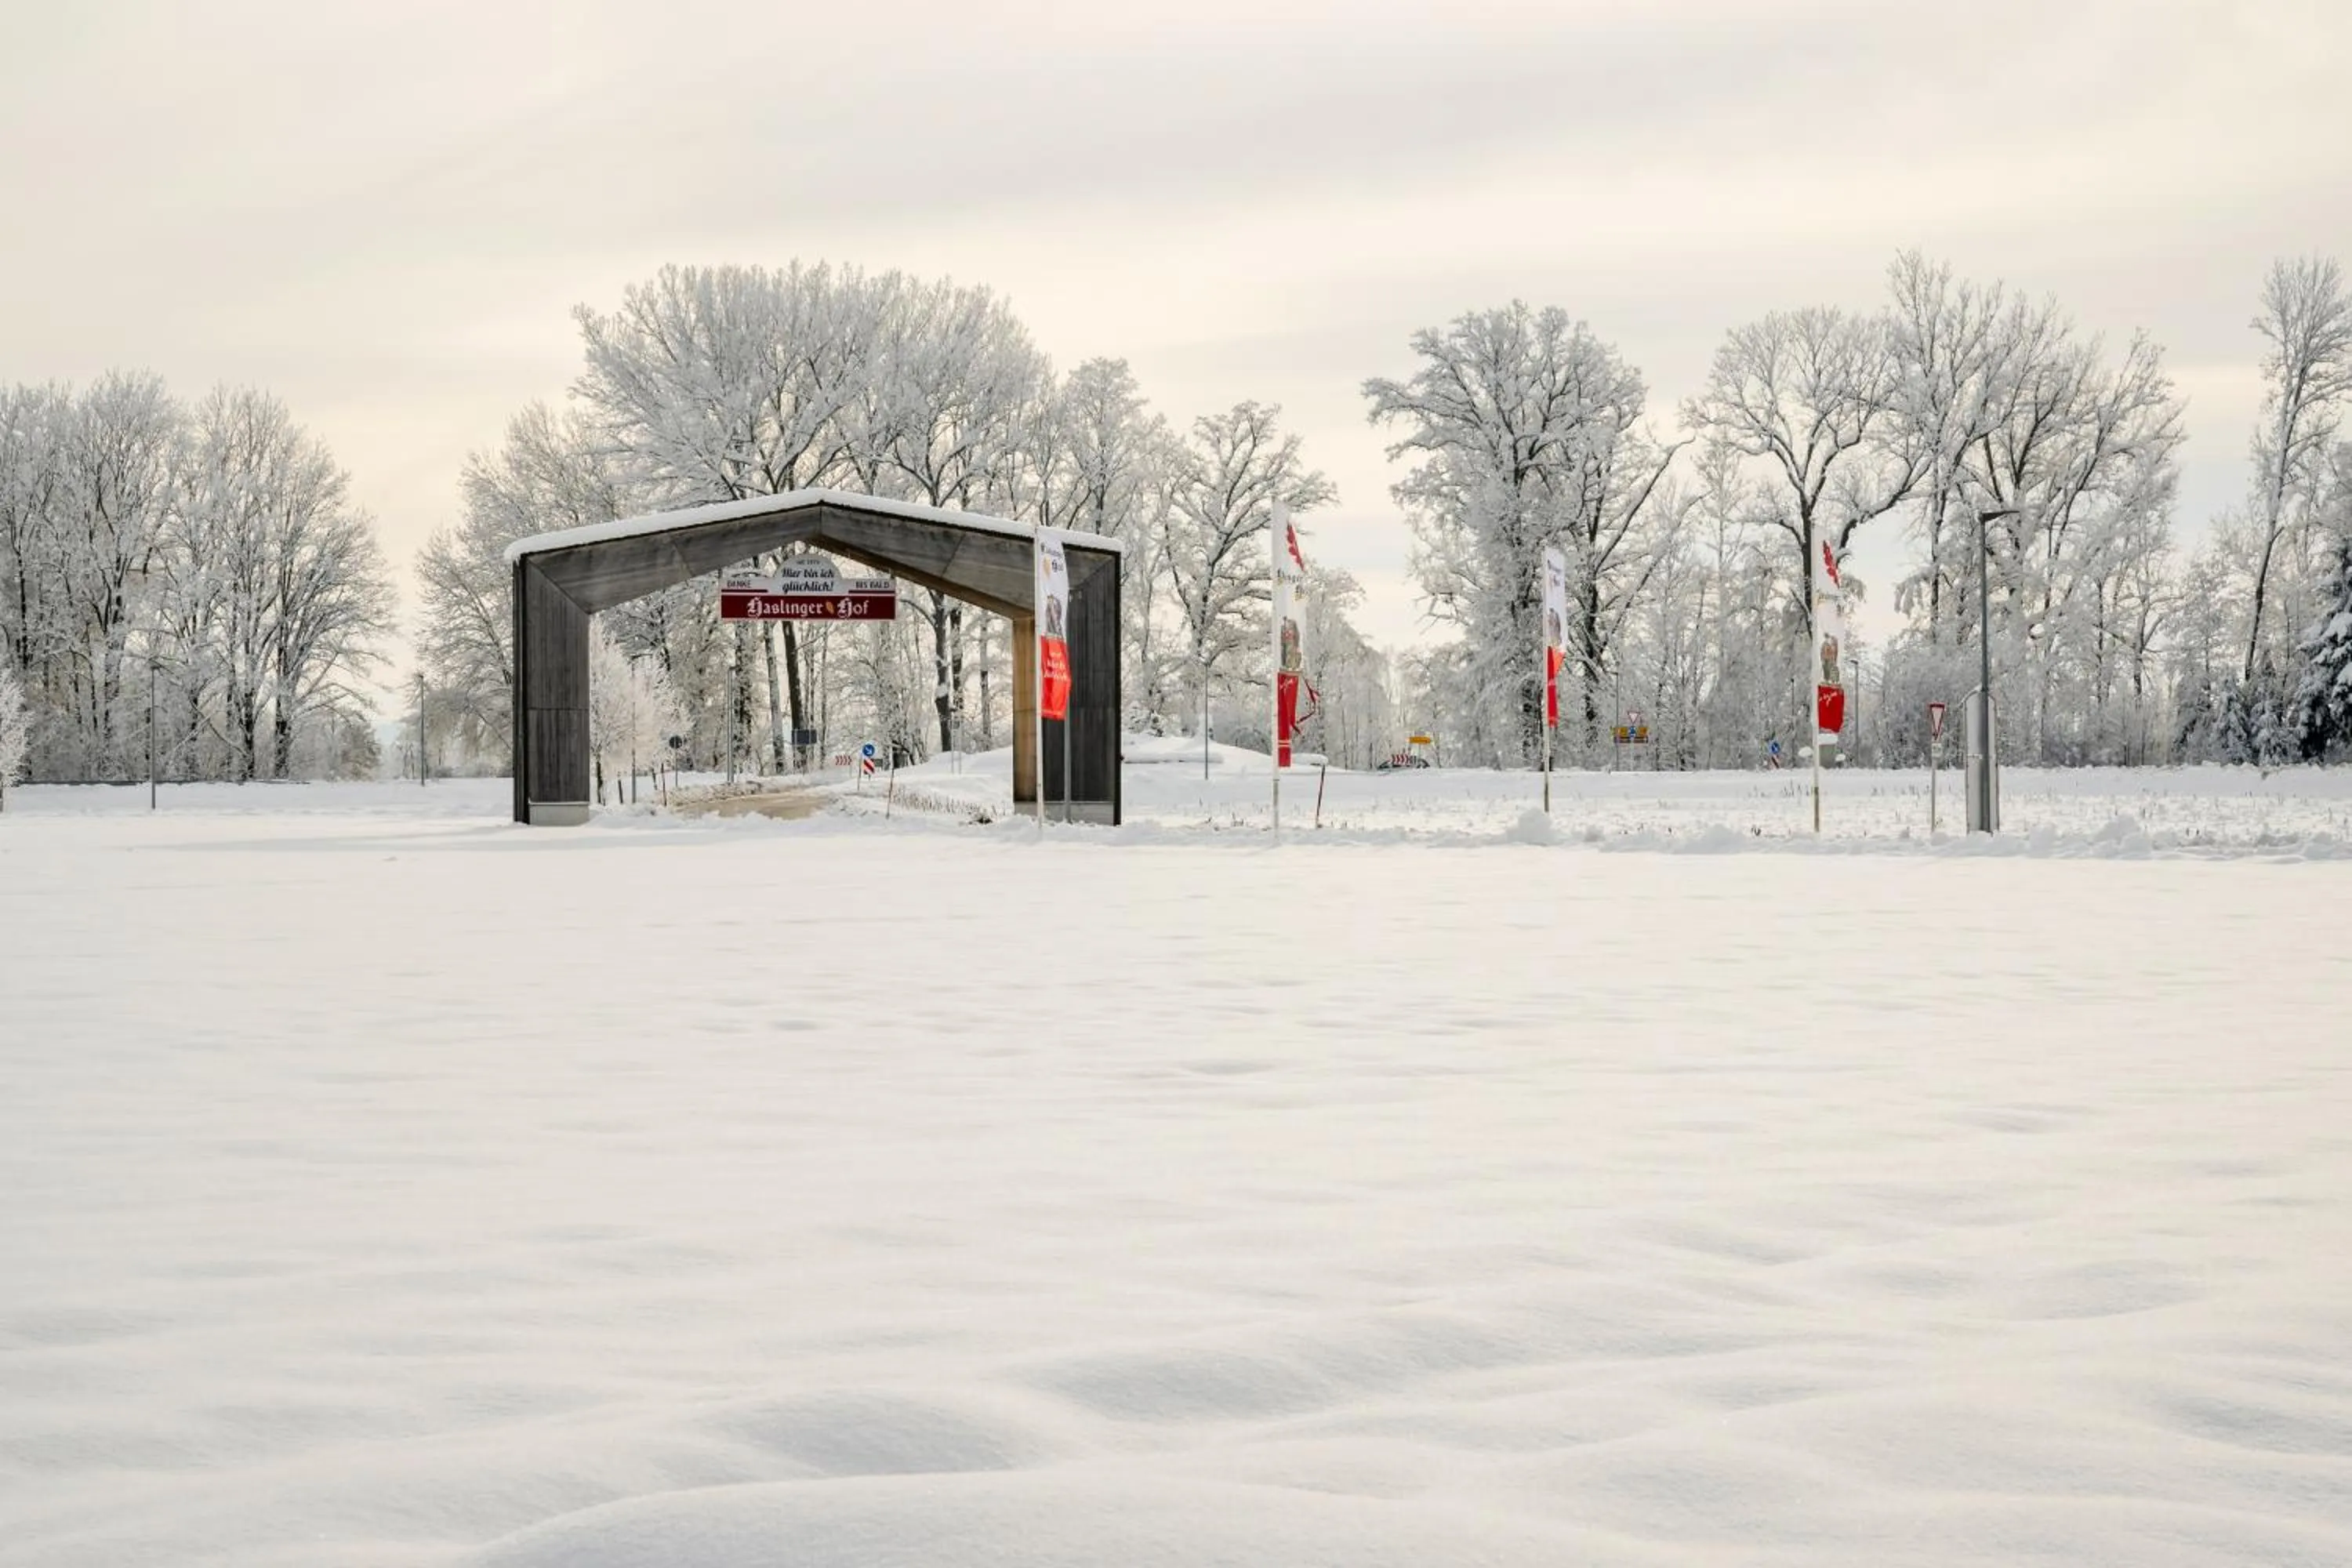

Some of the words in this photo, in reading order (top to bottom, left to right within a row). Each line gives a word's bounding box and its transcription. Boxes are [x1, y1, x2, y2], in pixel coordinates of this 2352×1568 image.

[782, 568, 801, 578] Hier
[804, 568, 818, 578] bin
[820, 568, 834, 578] ich
[782, 582, 834, 593] glücklich!
[747, 597, 824, 617] Haslinger
[837, 597, 869, 619] Hof
